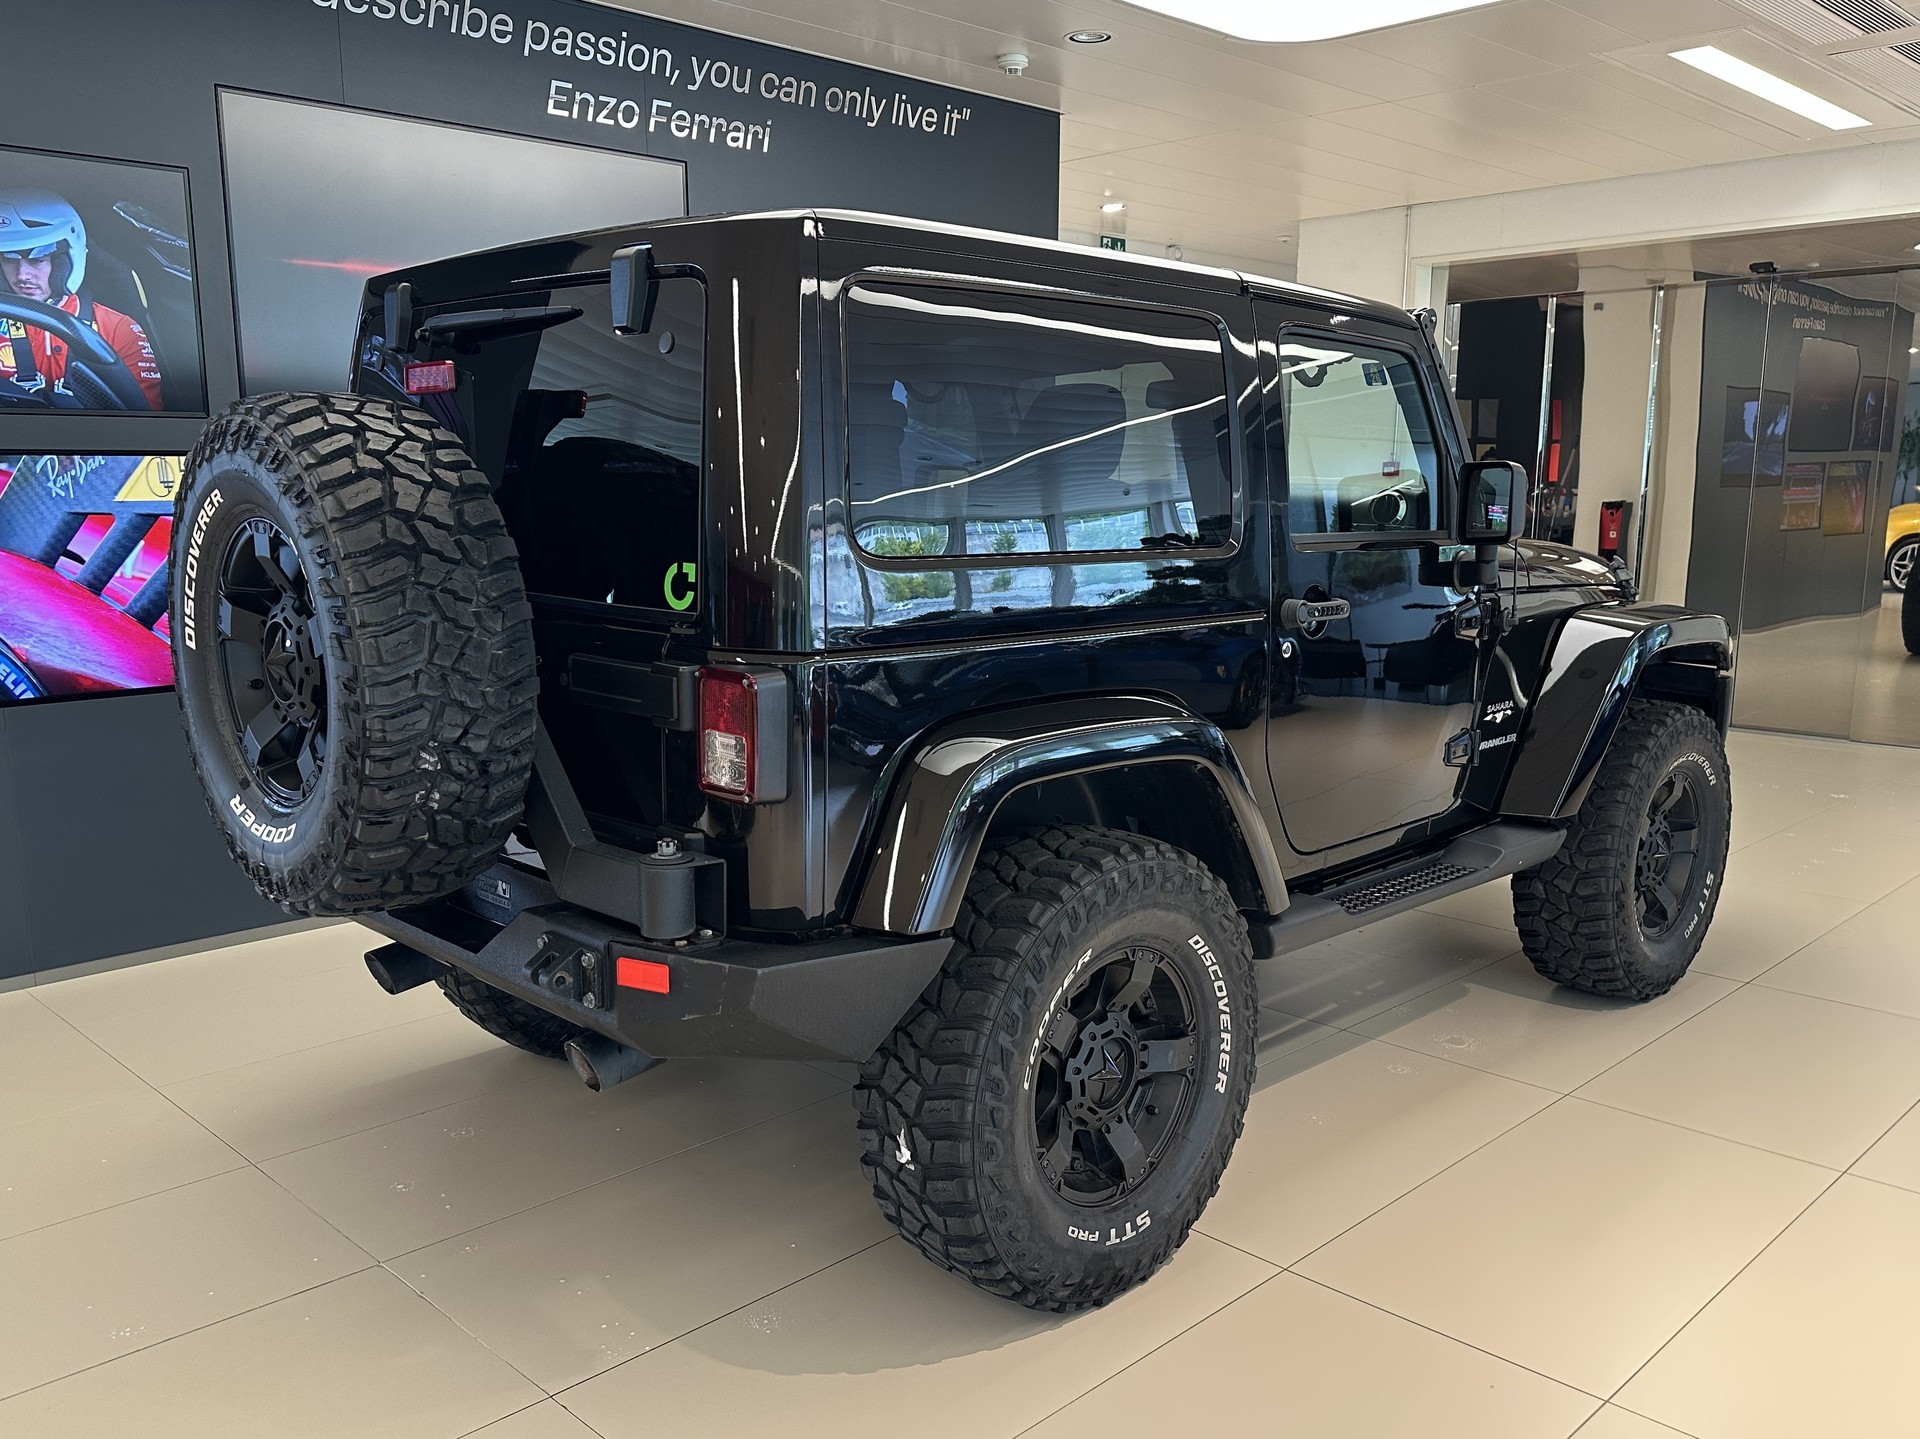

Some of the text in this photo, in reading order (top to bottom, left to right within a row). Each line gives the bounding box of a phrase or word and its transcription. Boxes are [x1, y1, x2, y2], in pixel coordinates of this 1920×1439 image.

[311, 0, 971, 136] scribe passion, you can only live it"
[547, 79, 772, 153] Enzo Ferrari
[184, 488, 224, 650] DISCOVERER
[1486, 700, 1514, 713] SAHARA
[229, 793, 297, 845] COOPER
[1684, 871, 1715, 939] STT PRO
[1023, 947, 1095, 1091] COOPER
[1187, 934, 1232, 1094] DISCOVERER
[1067, 1210, 1151, 1246] STT PRO
